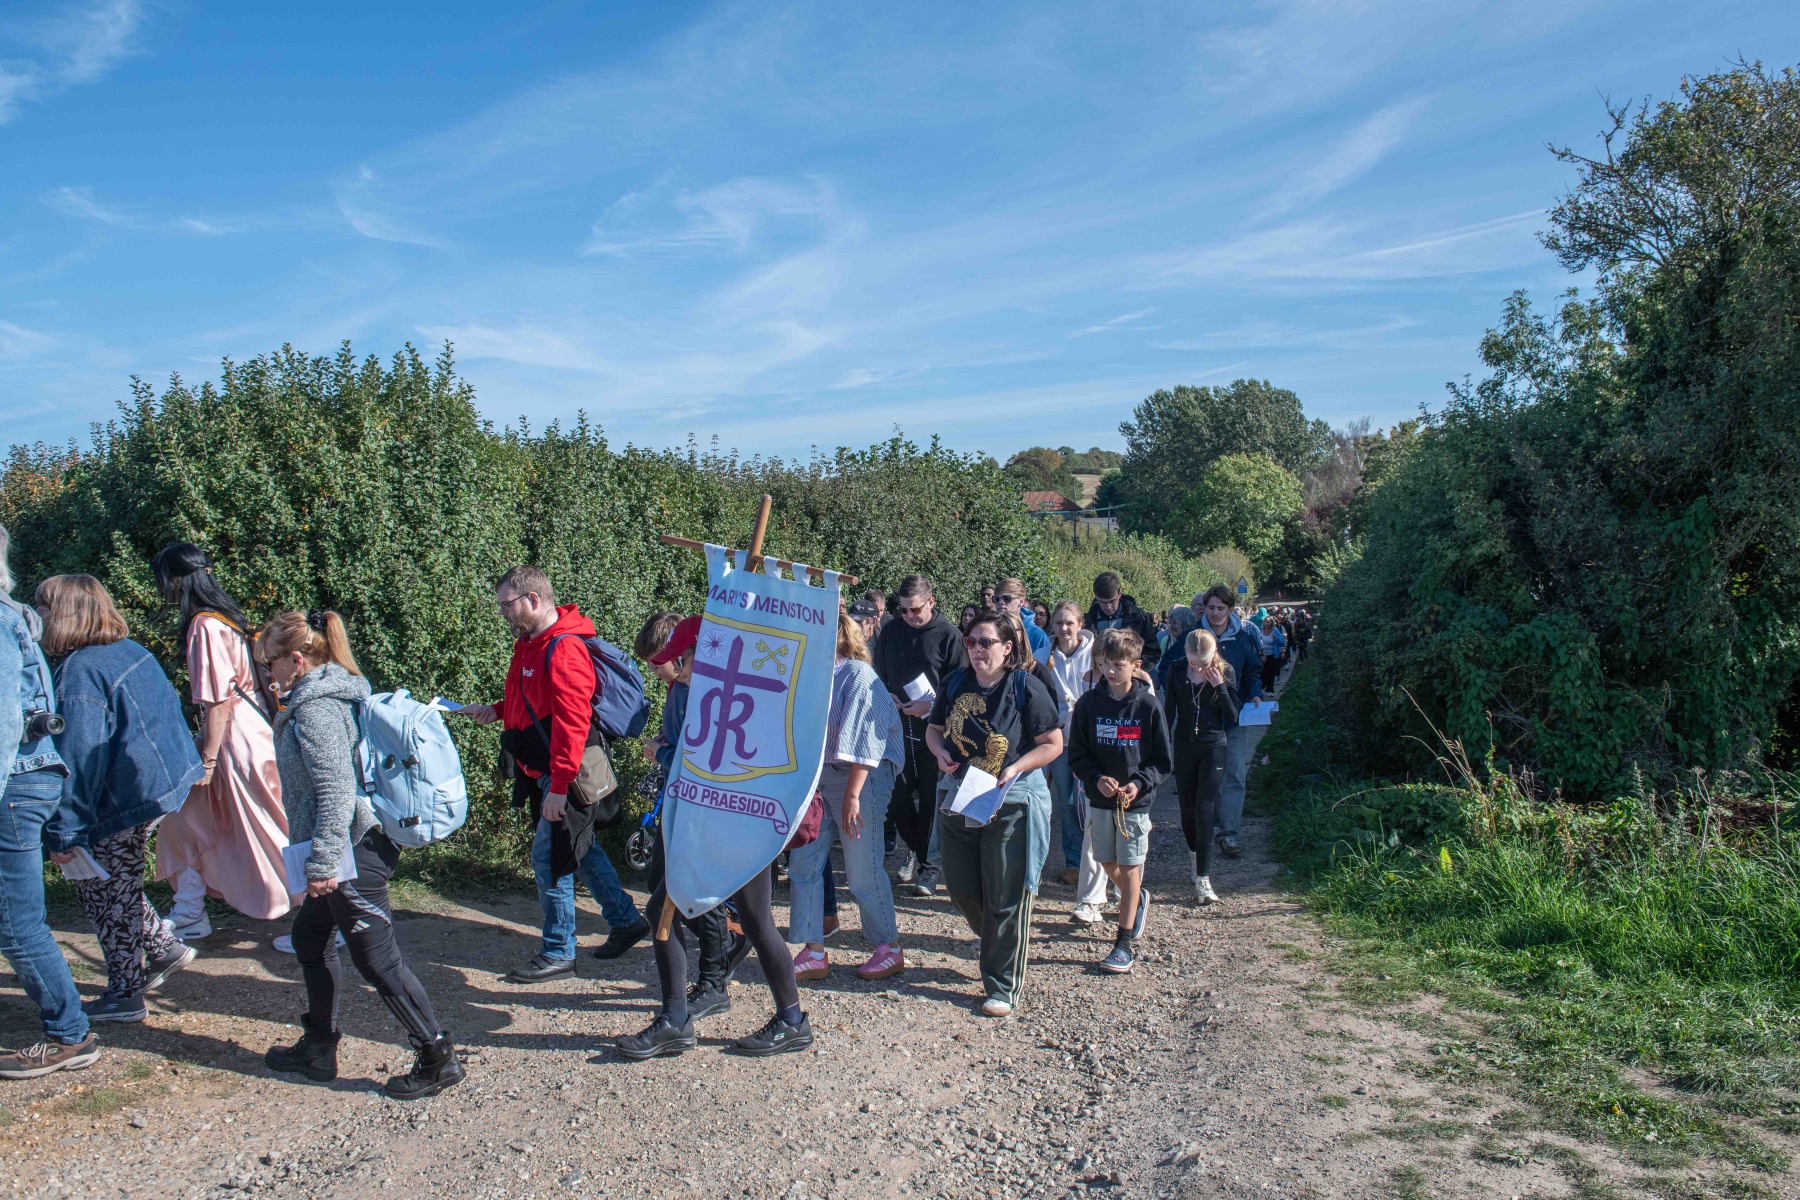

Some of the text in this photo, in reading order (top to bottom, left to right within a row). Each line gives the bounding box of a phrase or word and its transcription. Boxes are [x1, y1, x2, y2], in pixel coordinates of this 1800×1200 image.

[753, 595, 825, 625] MENSTON
[1097, 717, 1140, 726] TOMMY
[700, 788, 776, 817] PRAESIDIO
